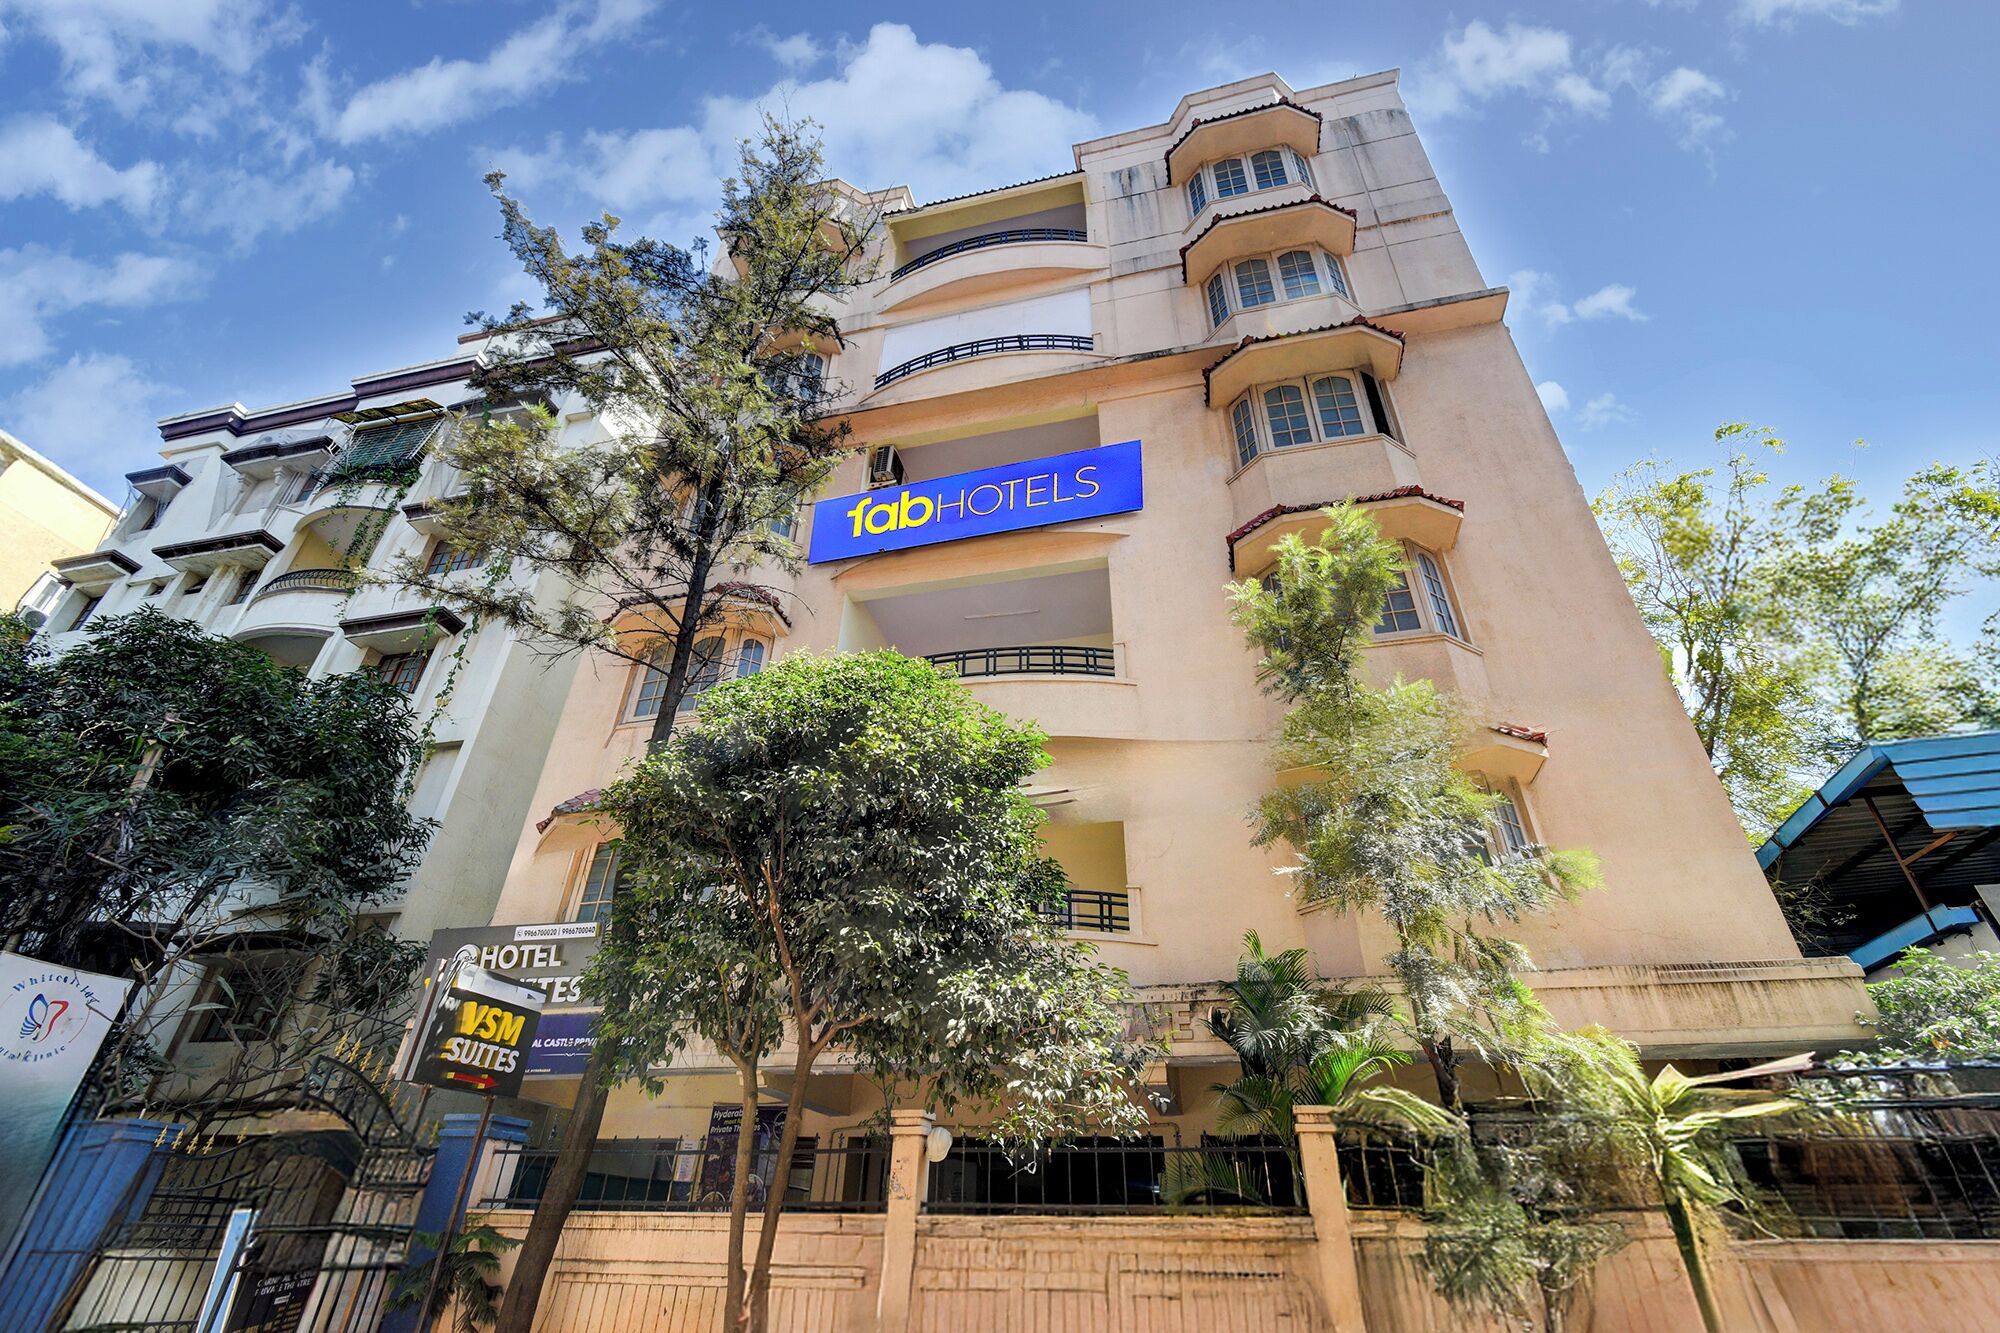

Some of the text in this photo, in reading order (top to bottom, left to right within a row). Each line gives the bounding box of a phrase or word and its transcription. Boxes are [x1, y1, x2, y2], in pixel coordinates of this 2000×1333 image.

[480, 944, 562, 970] HOTEL
[460, 1001, 526, 1047] VSM
[446, 1036, 520, 1074] SUITES
